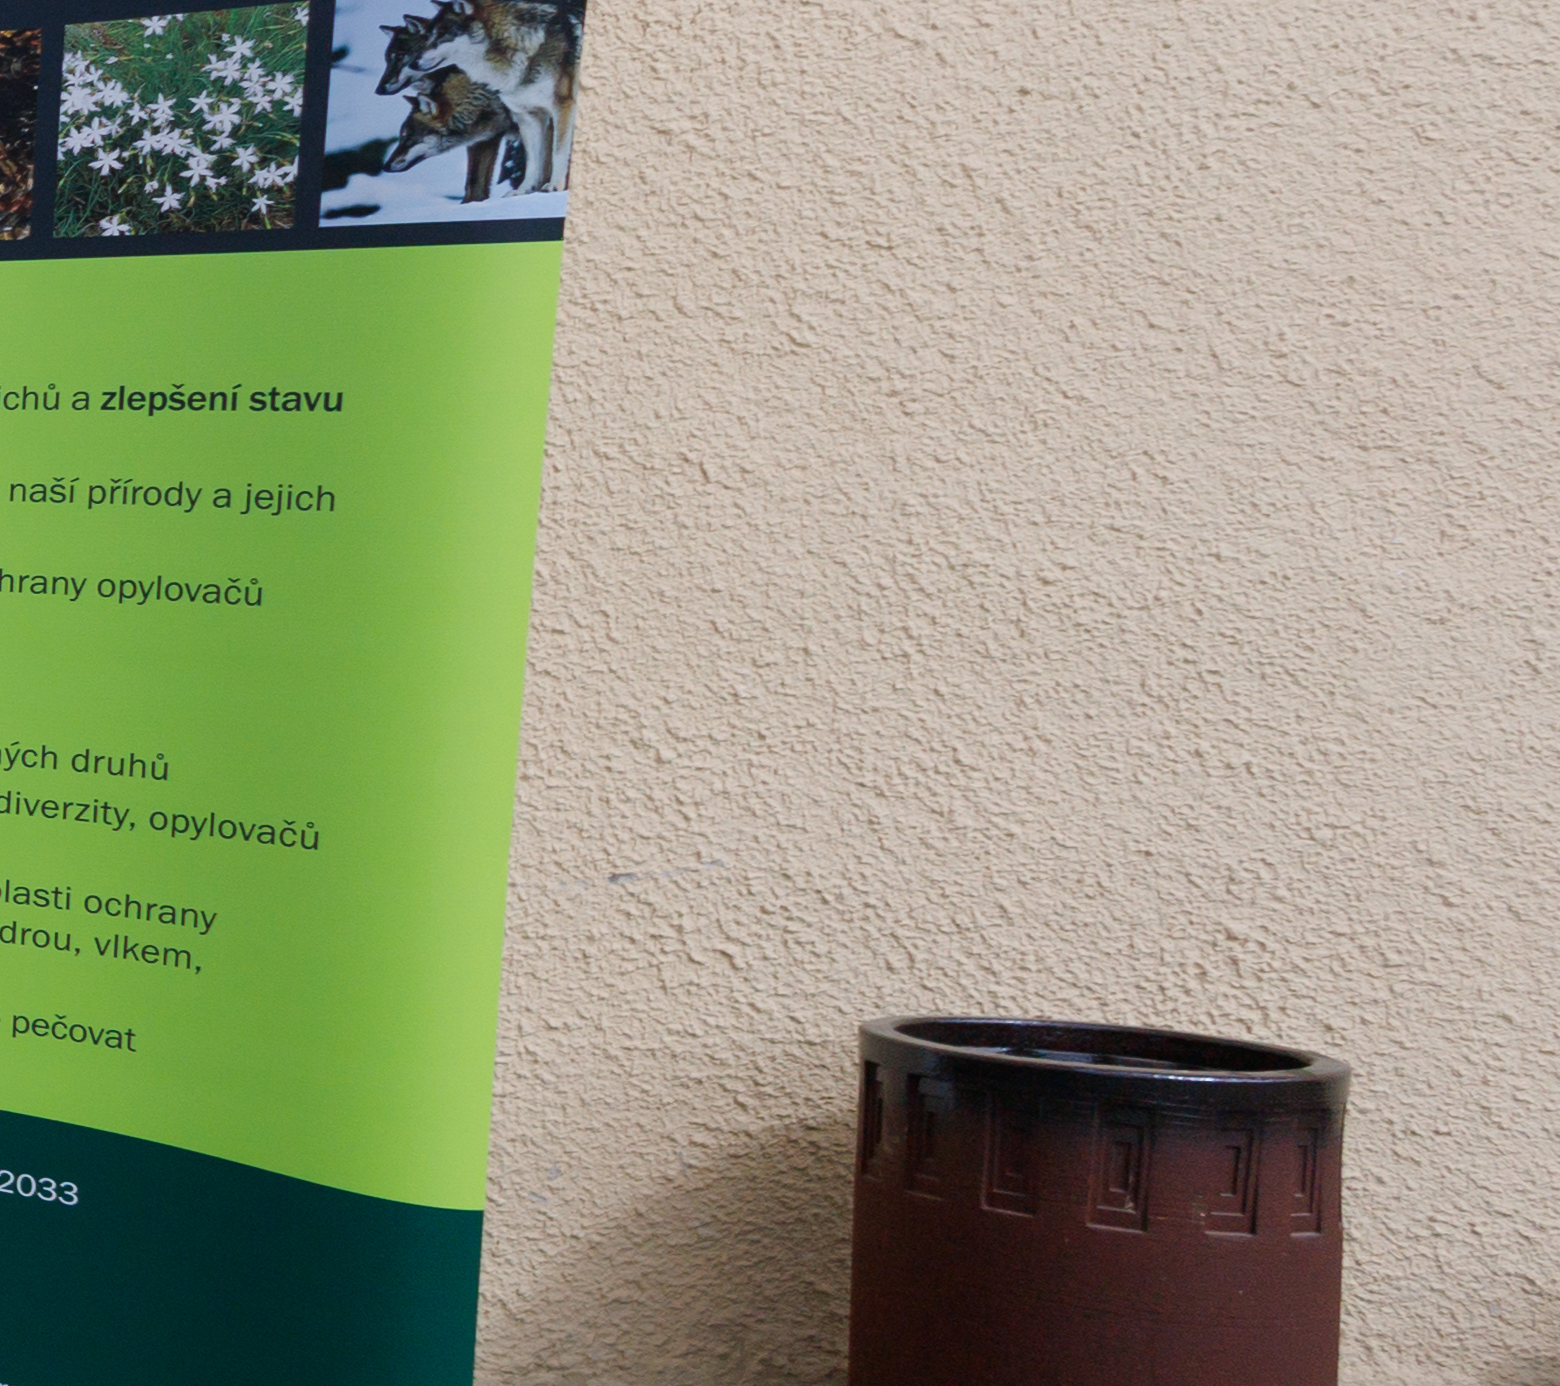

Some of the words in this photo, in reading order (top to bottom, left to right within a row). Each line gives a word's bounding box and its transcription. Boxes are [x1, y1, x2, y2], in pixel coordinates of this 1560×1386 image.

[71, 390, 90, 411] a
[100, 383, 243, 417] zlepšení
[248, 386, 344, 413] stavu
[9, 476, 80, 504] naší
[87, 478, 203, 514] přírody
[212, 487, 232, 509] a
[239, 482, 336, 517] jejich
[97, 575, 263, 607] opylovačů
[71, 748, 169, 781] druhů
[149, 811, 320, 851] opylovačů
[83, 893, 218, 936] ochrany
[94, 933, 202, 975] vlkem,
[12, 1013, 137, 1053] pečovat
